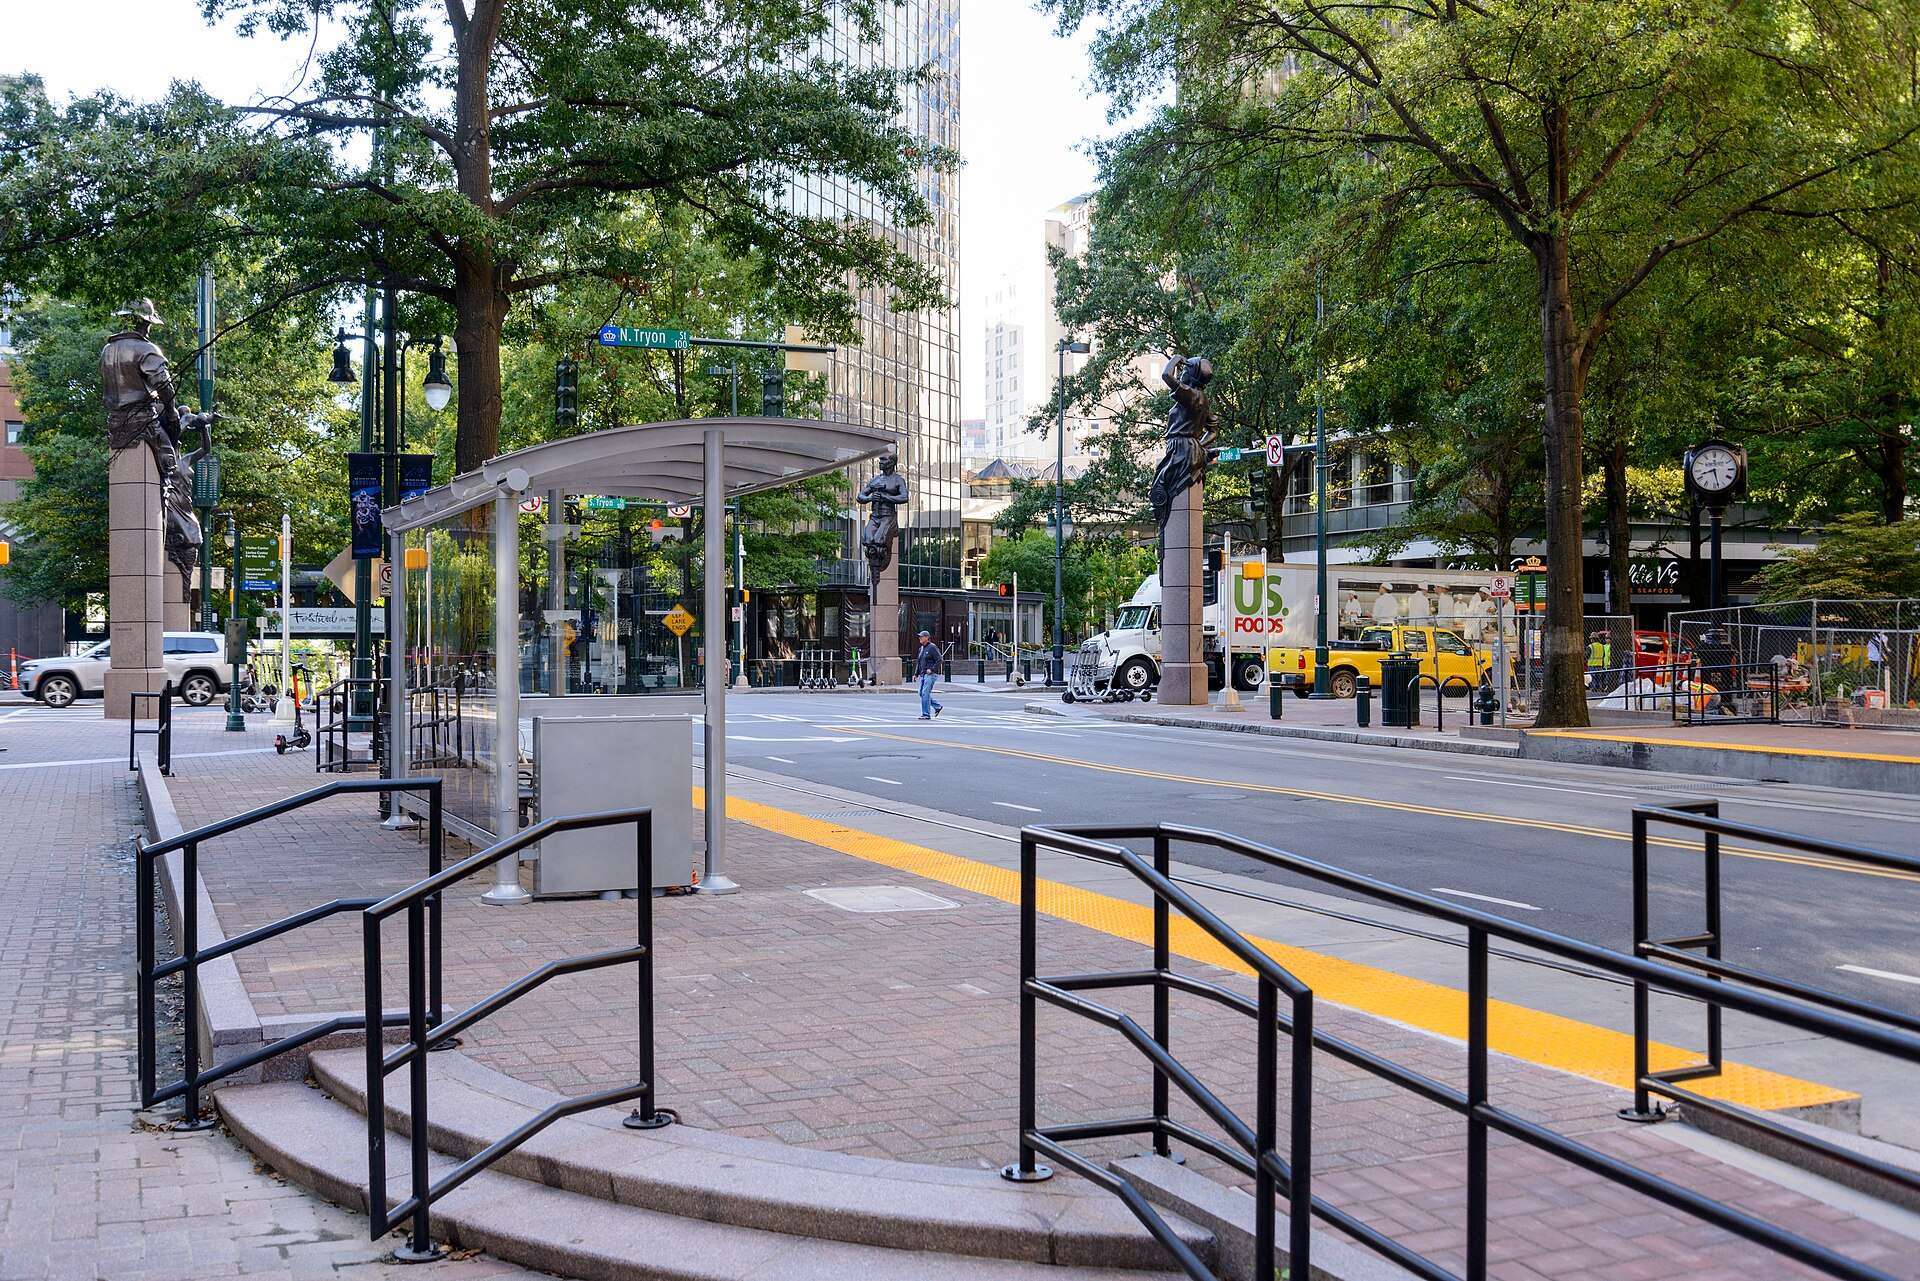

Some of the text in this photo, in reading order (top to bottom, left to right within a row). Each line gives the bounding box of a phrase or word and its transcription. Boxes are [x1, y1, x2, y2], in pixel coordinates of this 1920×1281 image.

[620, 328, 687, 346] N. Tryon St
[674, 340, 688, 349] 100
[596, 499, 614, 508] Tryon
[1657, 561, 1679, 584] V's
[1234, 616, 1284, 634] FOODS
